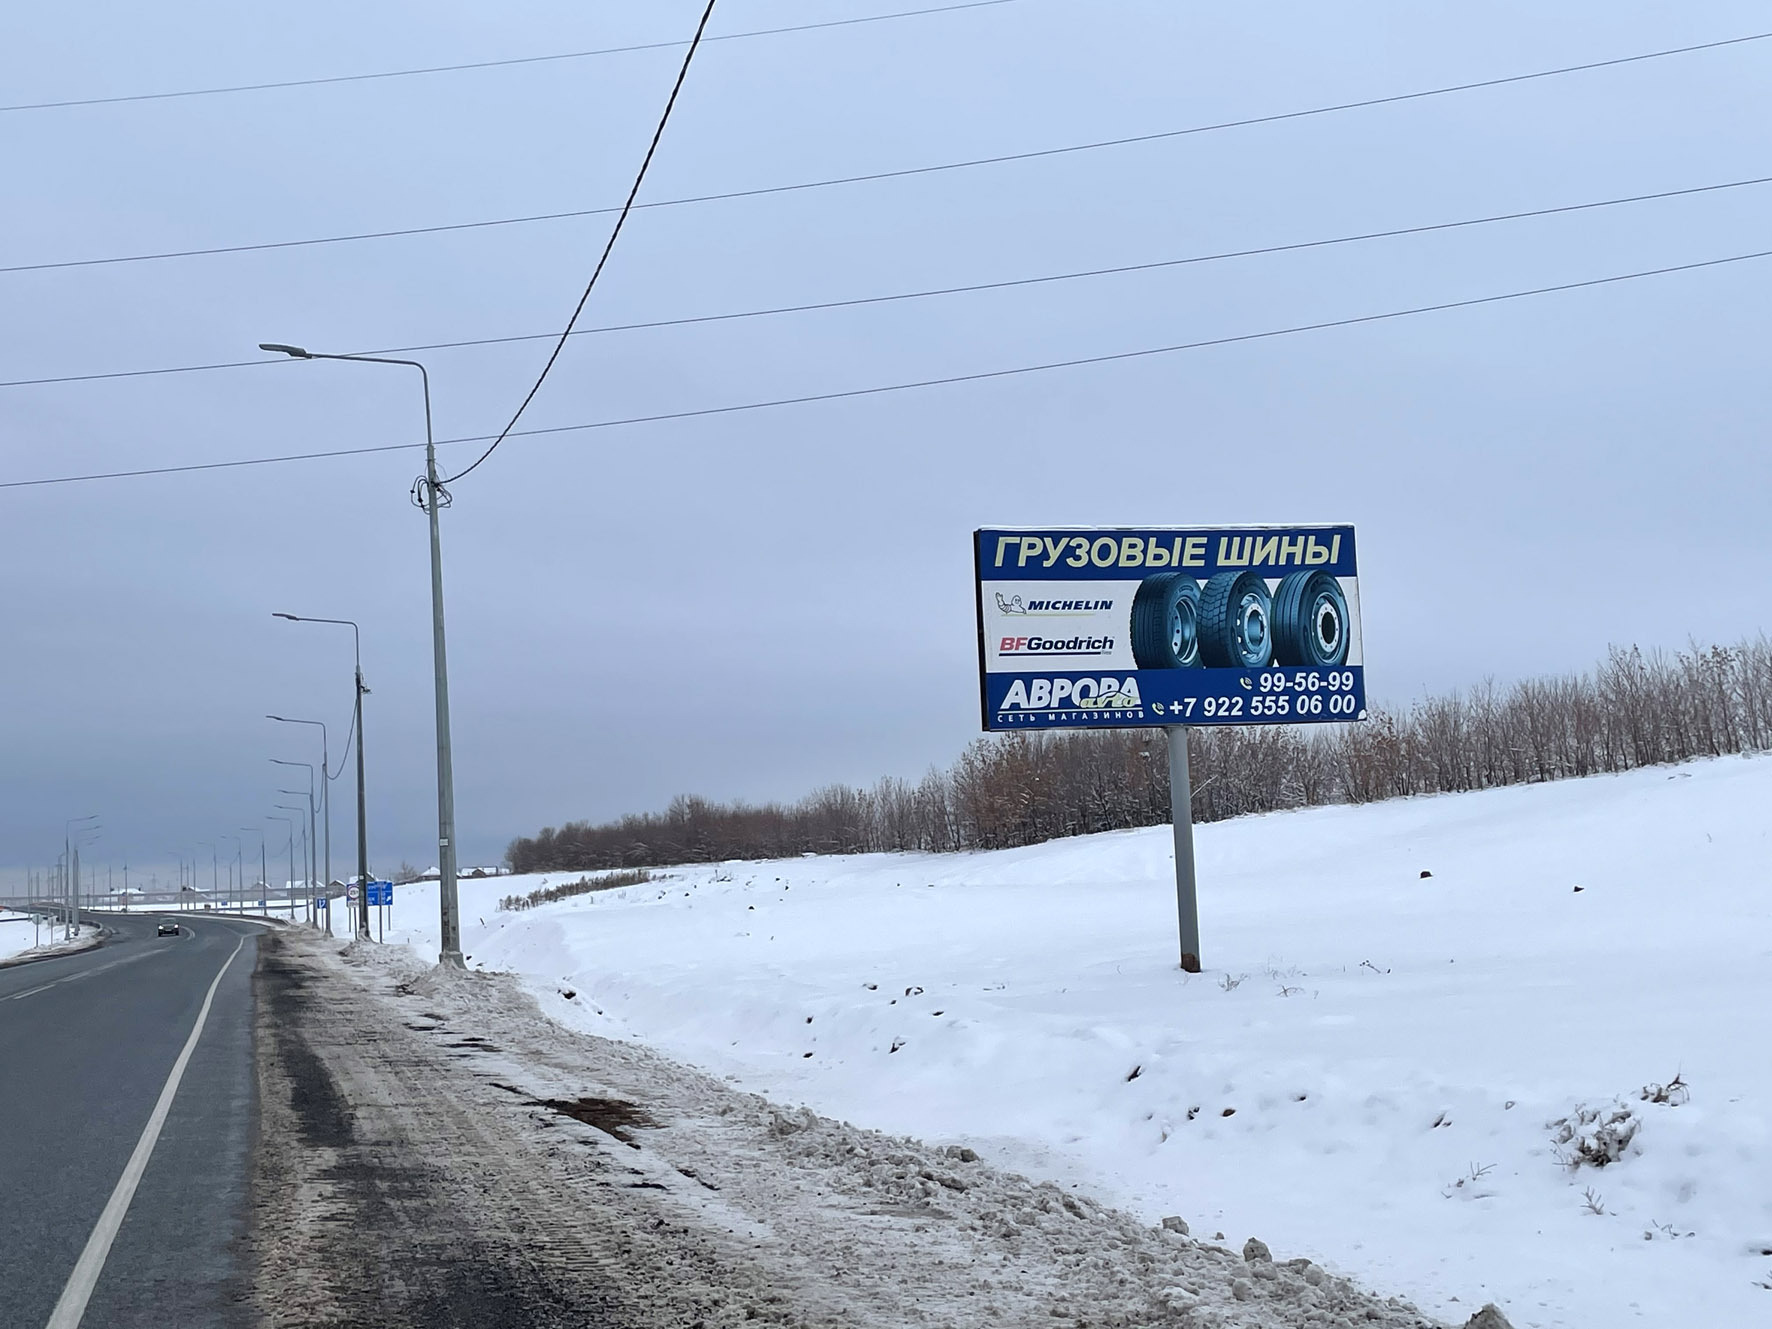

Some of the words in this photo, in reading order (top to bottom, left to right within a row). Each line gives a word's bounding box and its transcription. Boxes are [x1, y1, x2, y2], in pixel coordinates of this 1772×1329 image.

[994, 536, 1208, 568] ГРУЗОВЫЕ
[1216, 534, 1341, 567] ШИНЫ
[1028, 600, 1113, 610] MICHELIN
[1000, 636, 1114, 651] BFGoodrich
[1259, 671, 1354, 692] 99-56-99
[999, 677, 1142, 709] АВРОРА
[1169, 697, 1197, 717] +7
[1203, 696, 1243, 717] 922
[1250, 695, 1290, 716] 555
[1296, 694, 1323, 715] 06
[1329, 694, 1356, 714] 00
[997, 713, 1036, 723] СЕТЬ
[1048, 710, 1145, 721] МАГАЗИНОВ
